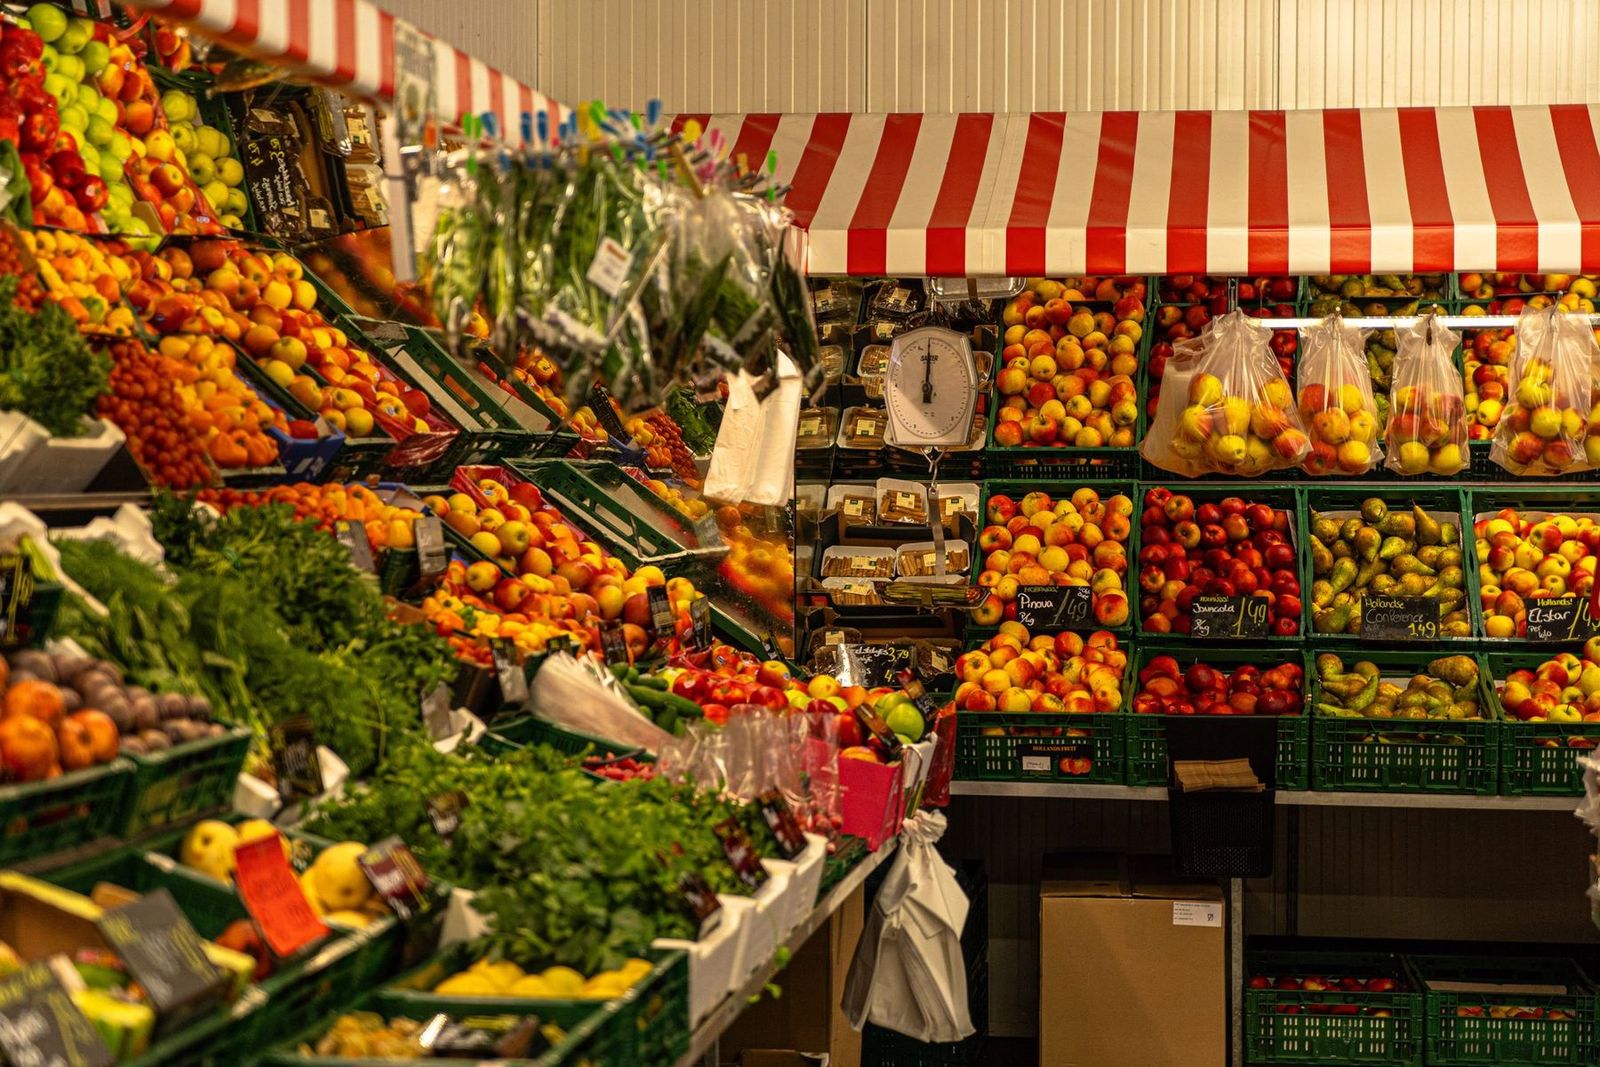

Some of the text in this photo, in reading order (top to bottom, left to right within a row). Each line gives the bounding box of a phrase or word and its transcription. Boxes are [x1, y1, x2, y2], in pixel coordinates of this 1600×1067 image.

[1018, 593, 1053, 609] Pinova
[1366, 609, 1424, 624] Conference
[1528, 608, 1571, 623] Elstar
